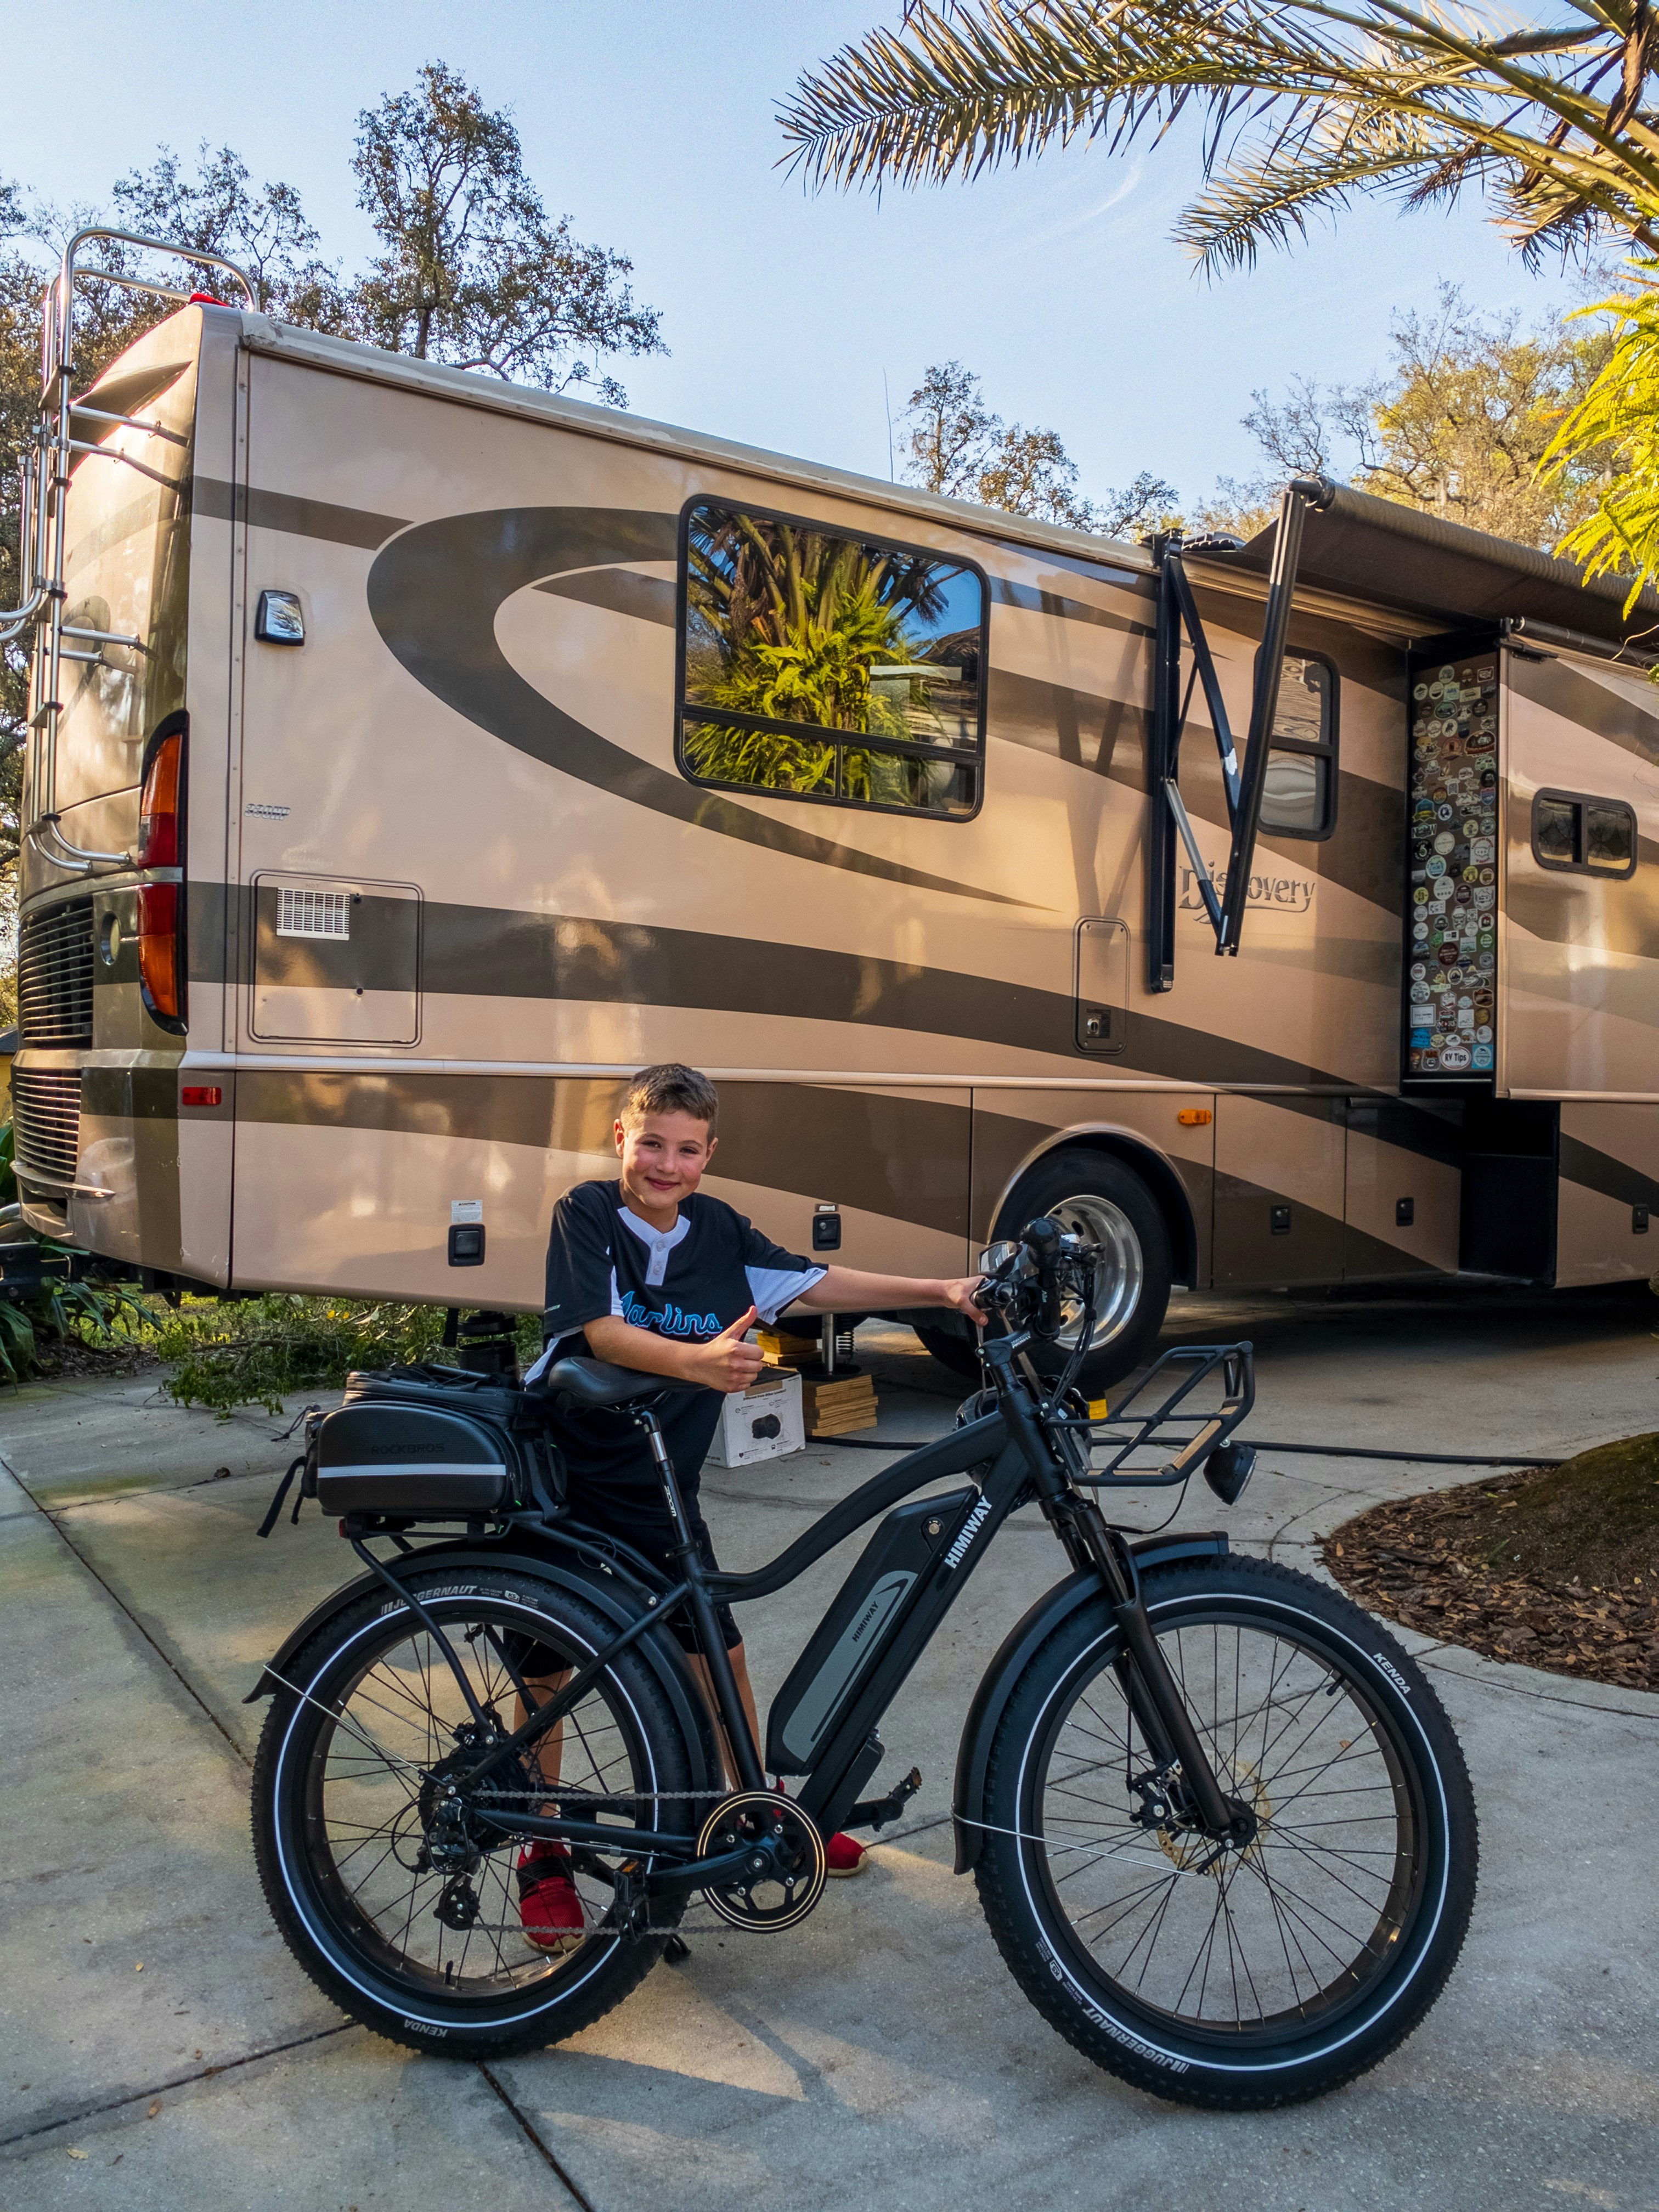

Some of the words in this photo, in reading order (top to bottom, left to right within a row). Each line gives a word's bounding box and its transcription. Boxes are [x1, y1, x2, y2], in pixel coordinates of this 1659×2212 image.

[1178, 860, 1315, 924] Disovery
[1445, 1053, 1453, 1062] RV
[1454, 1053, 1466, 1063] Tips
[371, 1443, 444, 1454] ROCKBROS
[944, 1496, 992, 1569] HIMIWAY
[393, 1585, 477, 1609] JUGERNAUT
[851, 1600, 879, 1643] HIMIWAY
[1373, 1652, 1411, 1694] KENDA
[404, 2019, 448, 2038] KENDA
[1082, 2007, 1173, 2067] JUGGERNAUT
